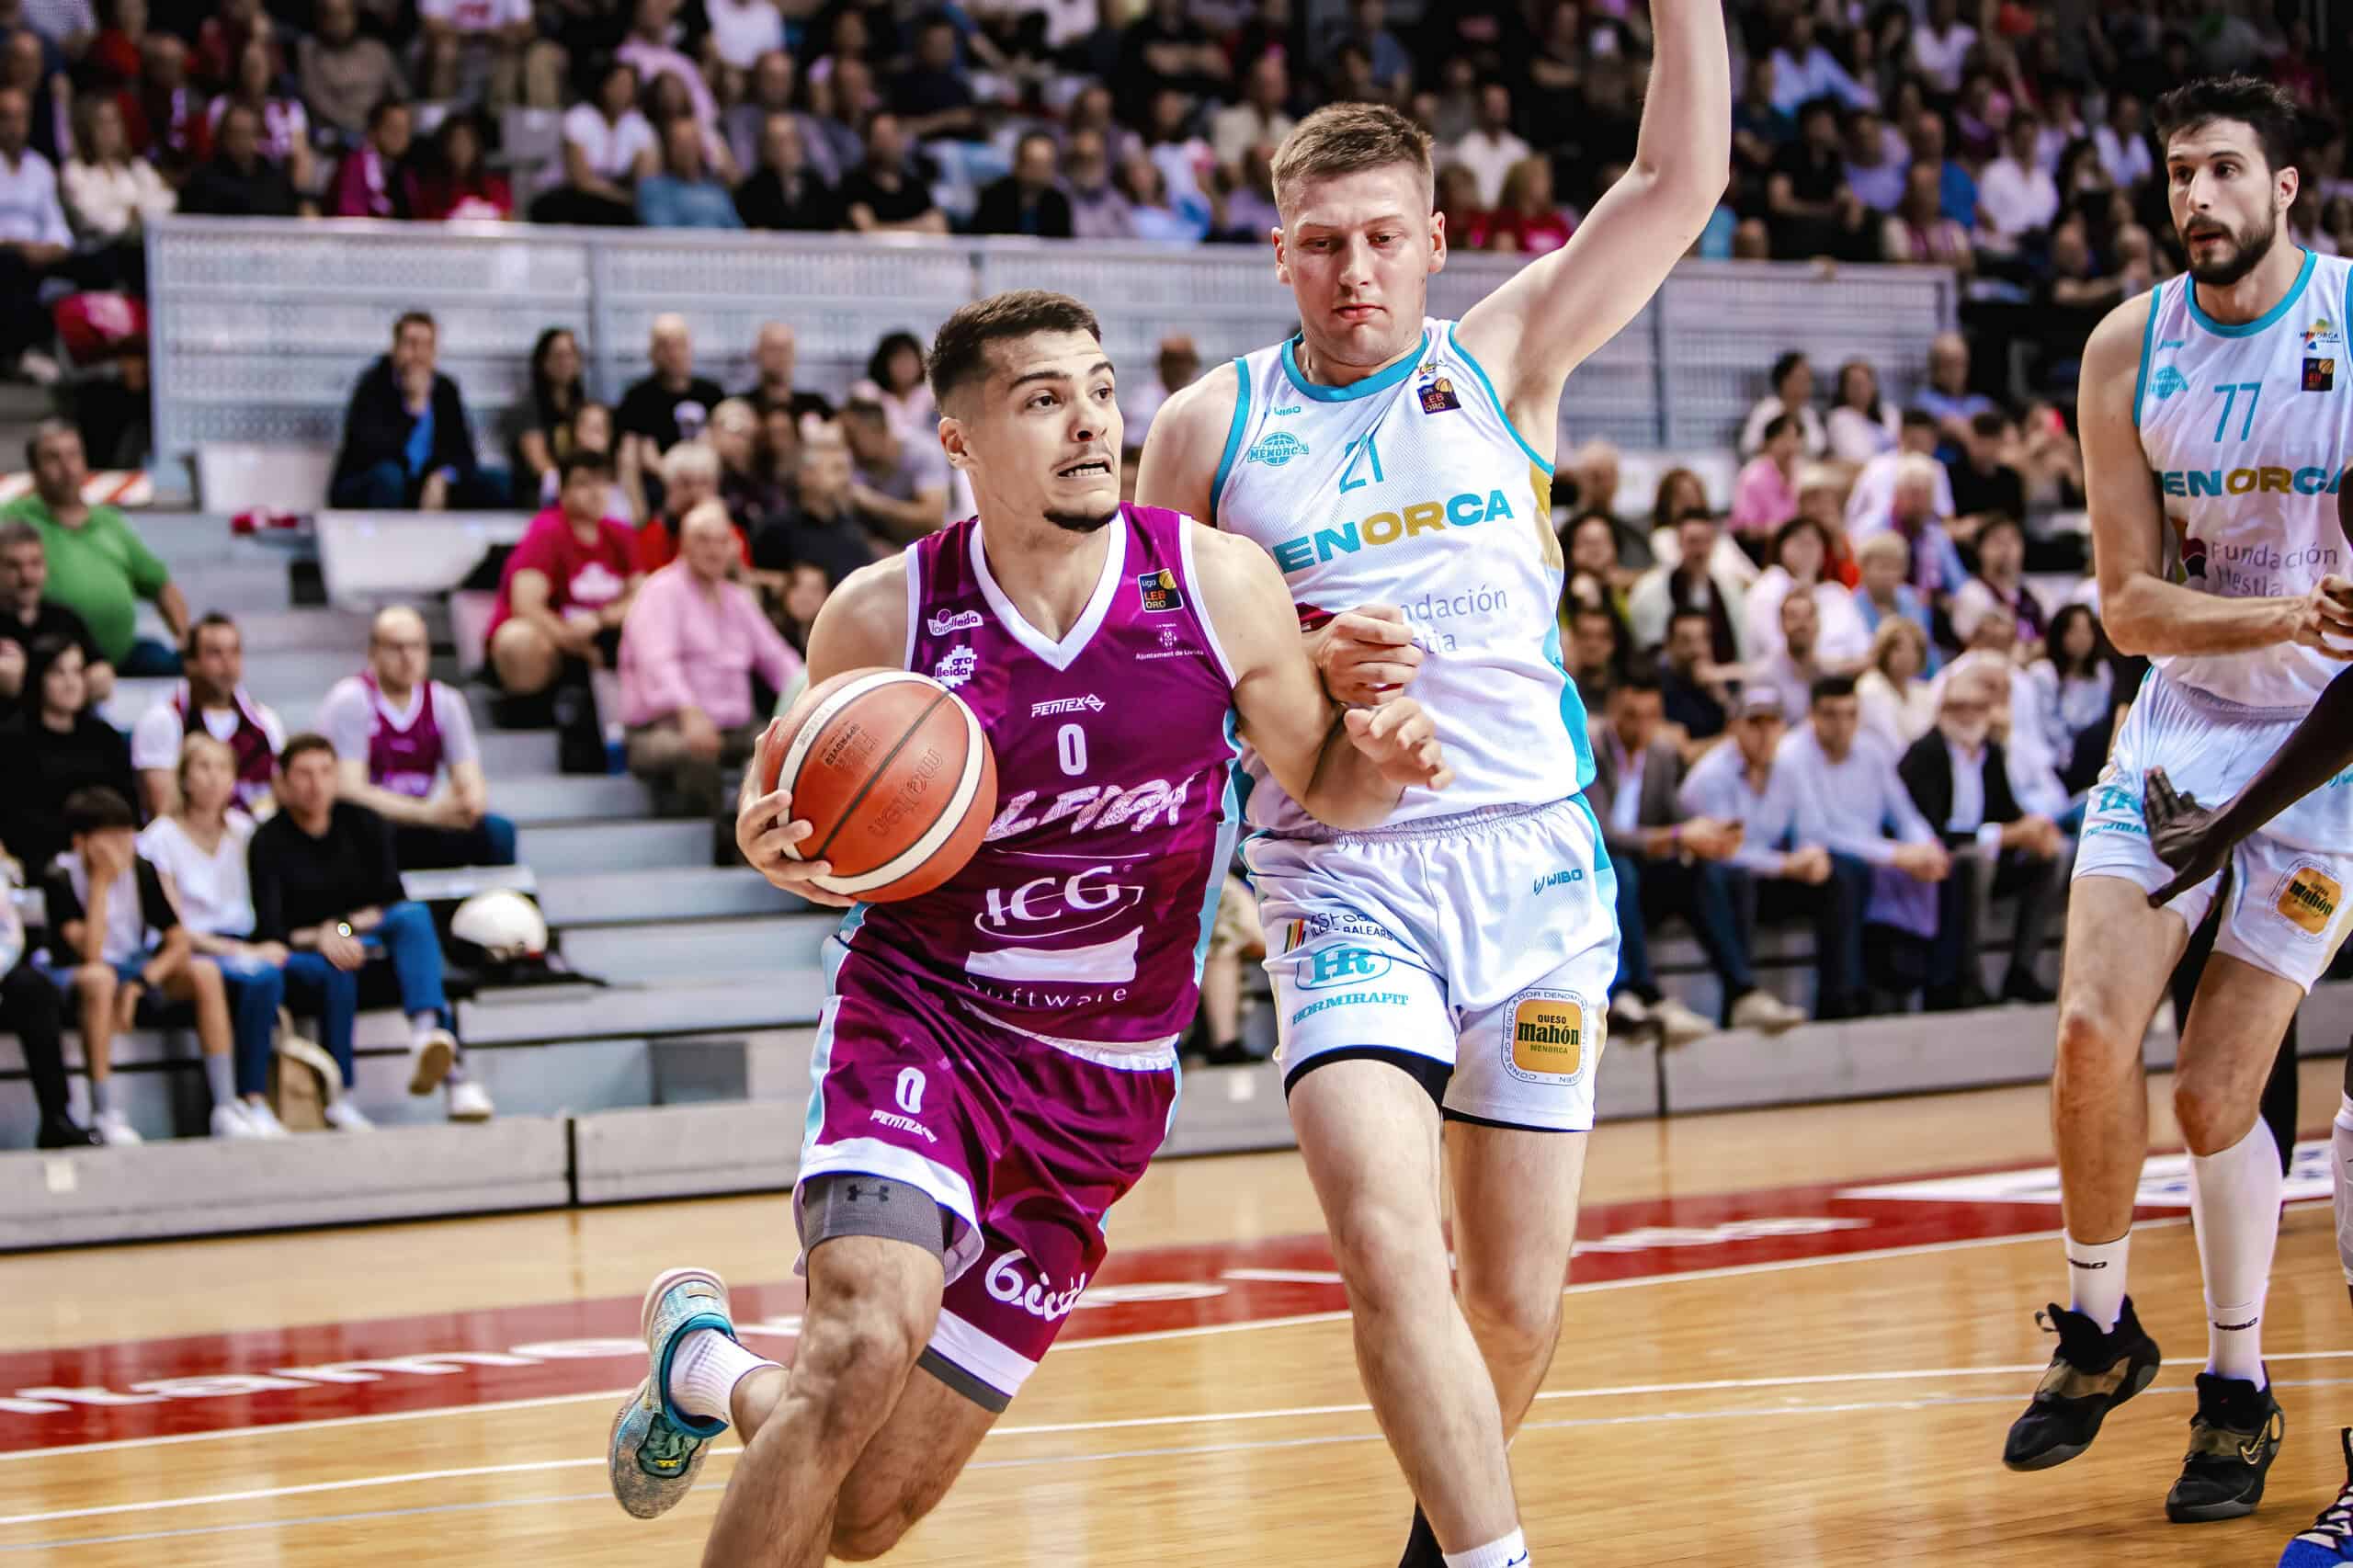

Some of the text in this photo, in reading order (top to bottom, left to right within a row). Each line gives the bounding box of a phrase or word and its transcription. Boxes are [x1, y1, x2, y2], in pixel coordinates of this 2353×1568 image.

[2213, 382, 2262, 442] 77
[1339, 433, 1385, 494] 21
[1144, 589, 1166, 601] LEB
[1145, 600, 1166, 608] ORO
[937, 666, 968, 677] lleida
[1031, 697, 1087, 718] PENTEX
[1057, 723, 1087, 776] 0
[1547, 869, 1583, 887] WIBO
[985, 865, 1120, 926] ICG
[1538, 1014, 1567, 1024] QUESO
[1518, 1021, 1579, 1045] mahón
